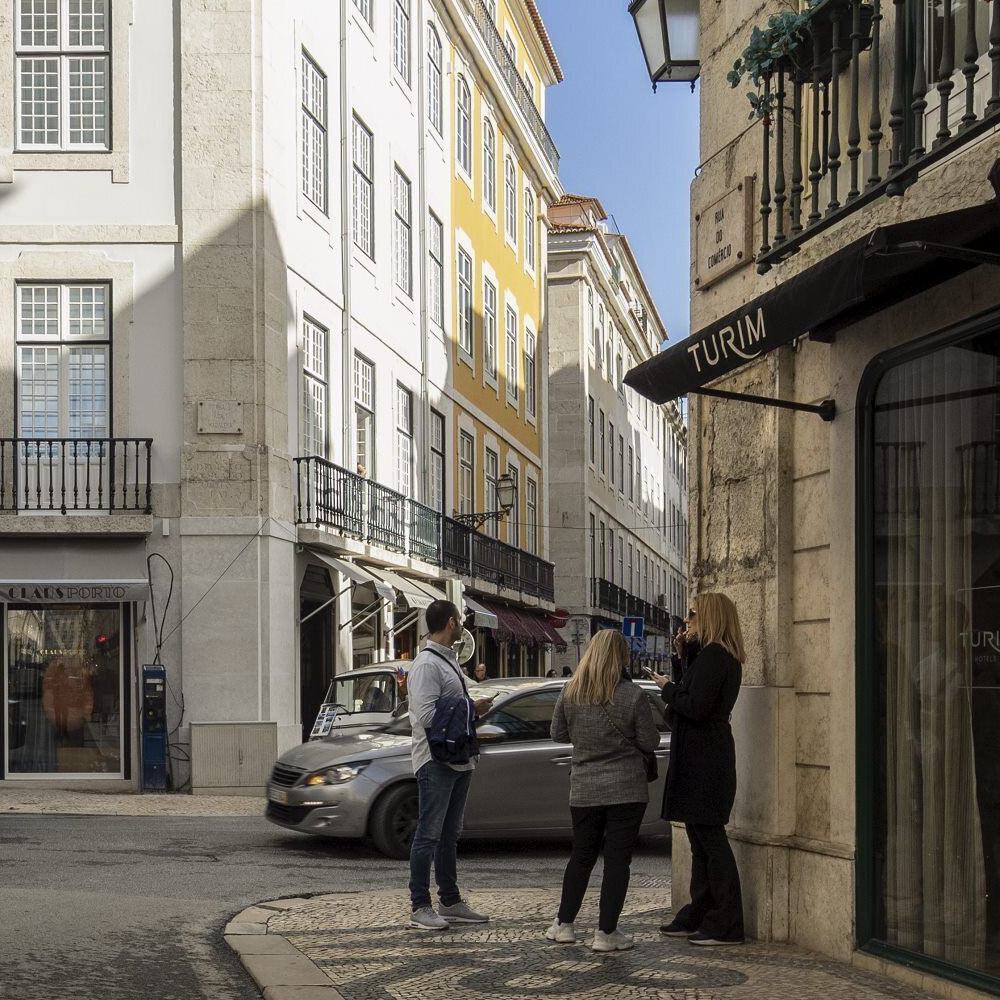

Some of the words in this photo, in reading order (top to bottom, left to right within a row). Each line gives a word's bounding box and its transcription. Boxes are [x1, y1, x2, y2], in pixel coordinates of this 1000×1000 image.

[714, 207, 725, 225] RUA
[715, 229, 723, 244] DO
[707, 243, 732, 269] COMÉRCIO
[687, 307, 766, 372] TURIM
